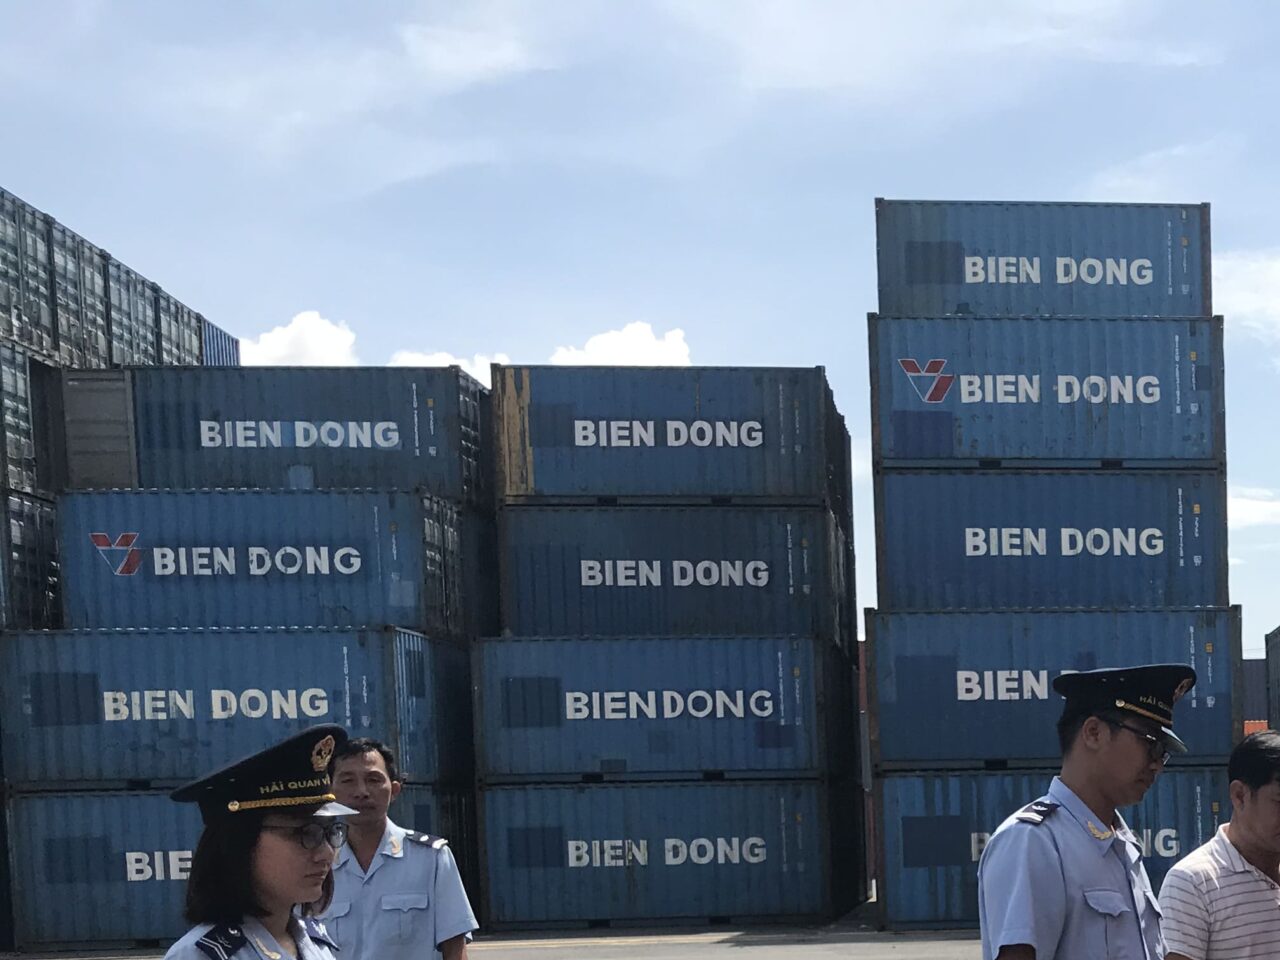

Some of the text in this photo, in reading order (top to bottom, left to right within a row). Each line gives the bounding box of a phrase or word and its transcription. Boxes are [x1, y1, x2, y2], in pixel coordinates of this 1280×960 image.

[964, 256, 1041, 284] BIEN
[1056, 258, 1154, 285] DONG
[960, 374, 1040, 404] BIEN
[1057, 375, 1161, 404] DONG
[200, 421, 281, 448] BIEN
[295, 421, 400, 448] DONG
[574, 420, 655, 447] BIEN
[666, 420, 763, 447] DONG
[965, 528, 1047, 556] BIEN
[1061, 528, 1164, 556] DONG
[153, 546, 236, 576] BIEN
[249, 546, 361, 575] DONG
[580, 560, 769, 587] BIEN DONG
[956, 670, 1049, 701] BIEN
[103, 689, 194, 721] BIEN
[211, 688, 329, 720] DONG
[287, 779, 320, 790] QUAN
[125, 850, 192, 882] BIE
[567, 836, 767, 868] BIEN DONG
